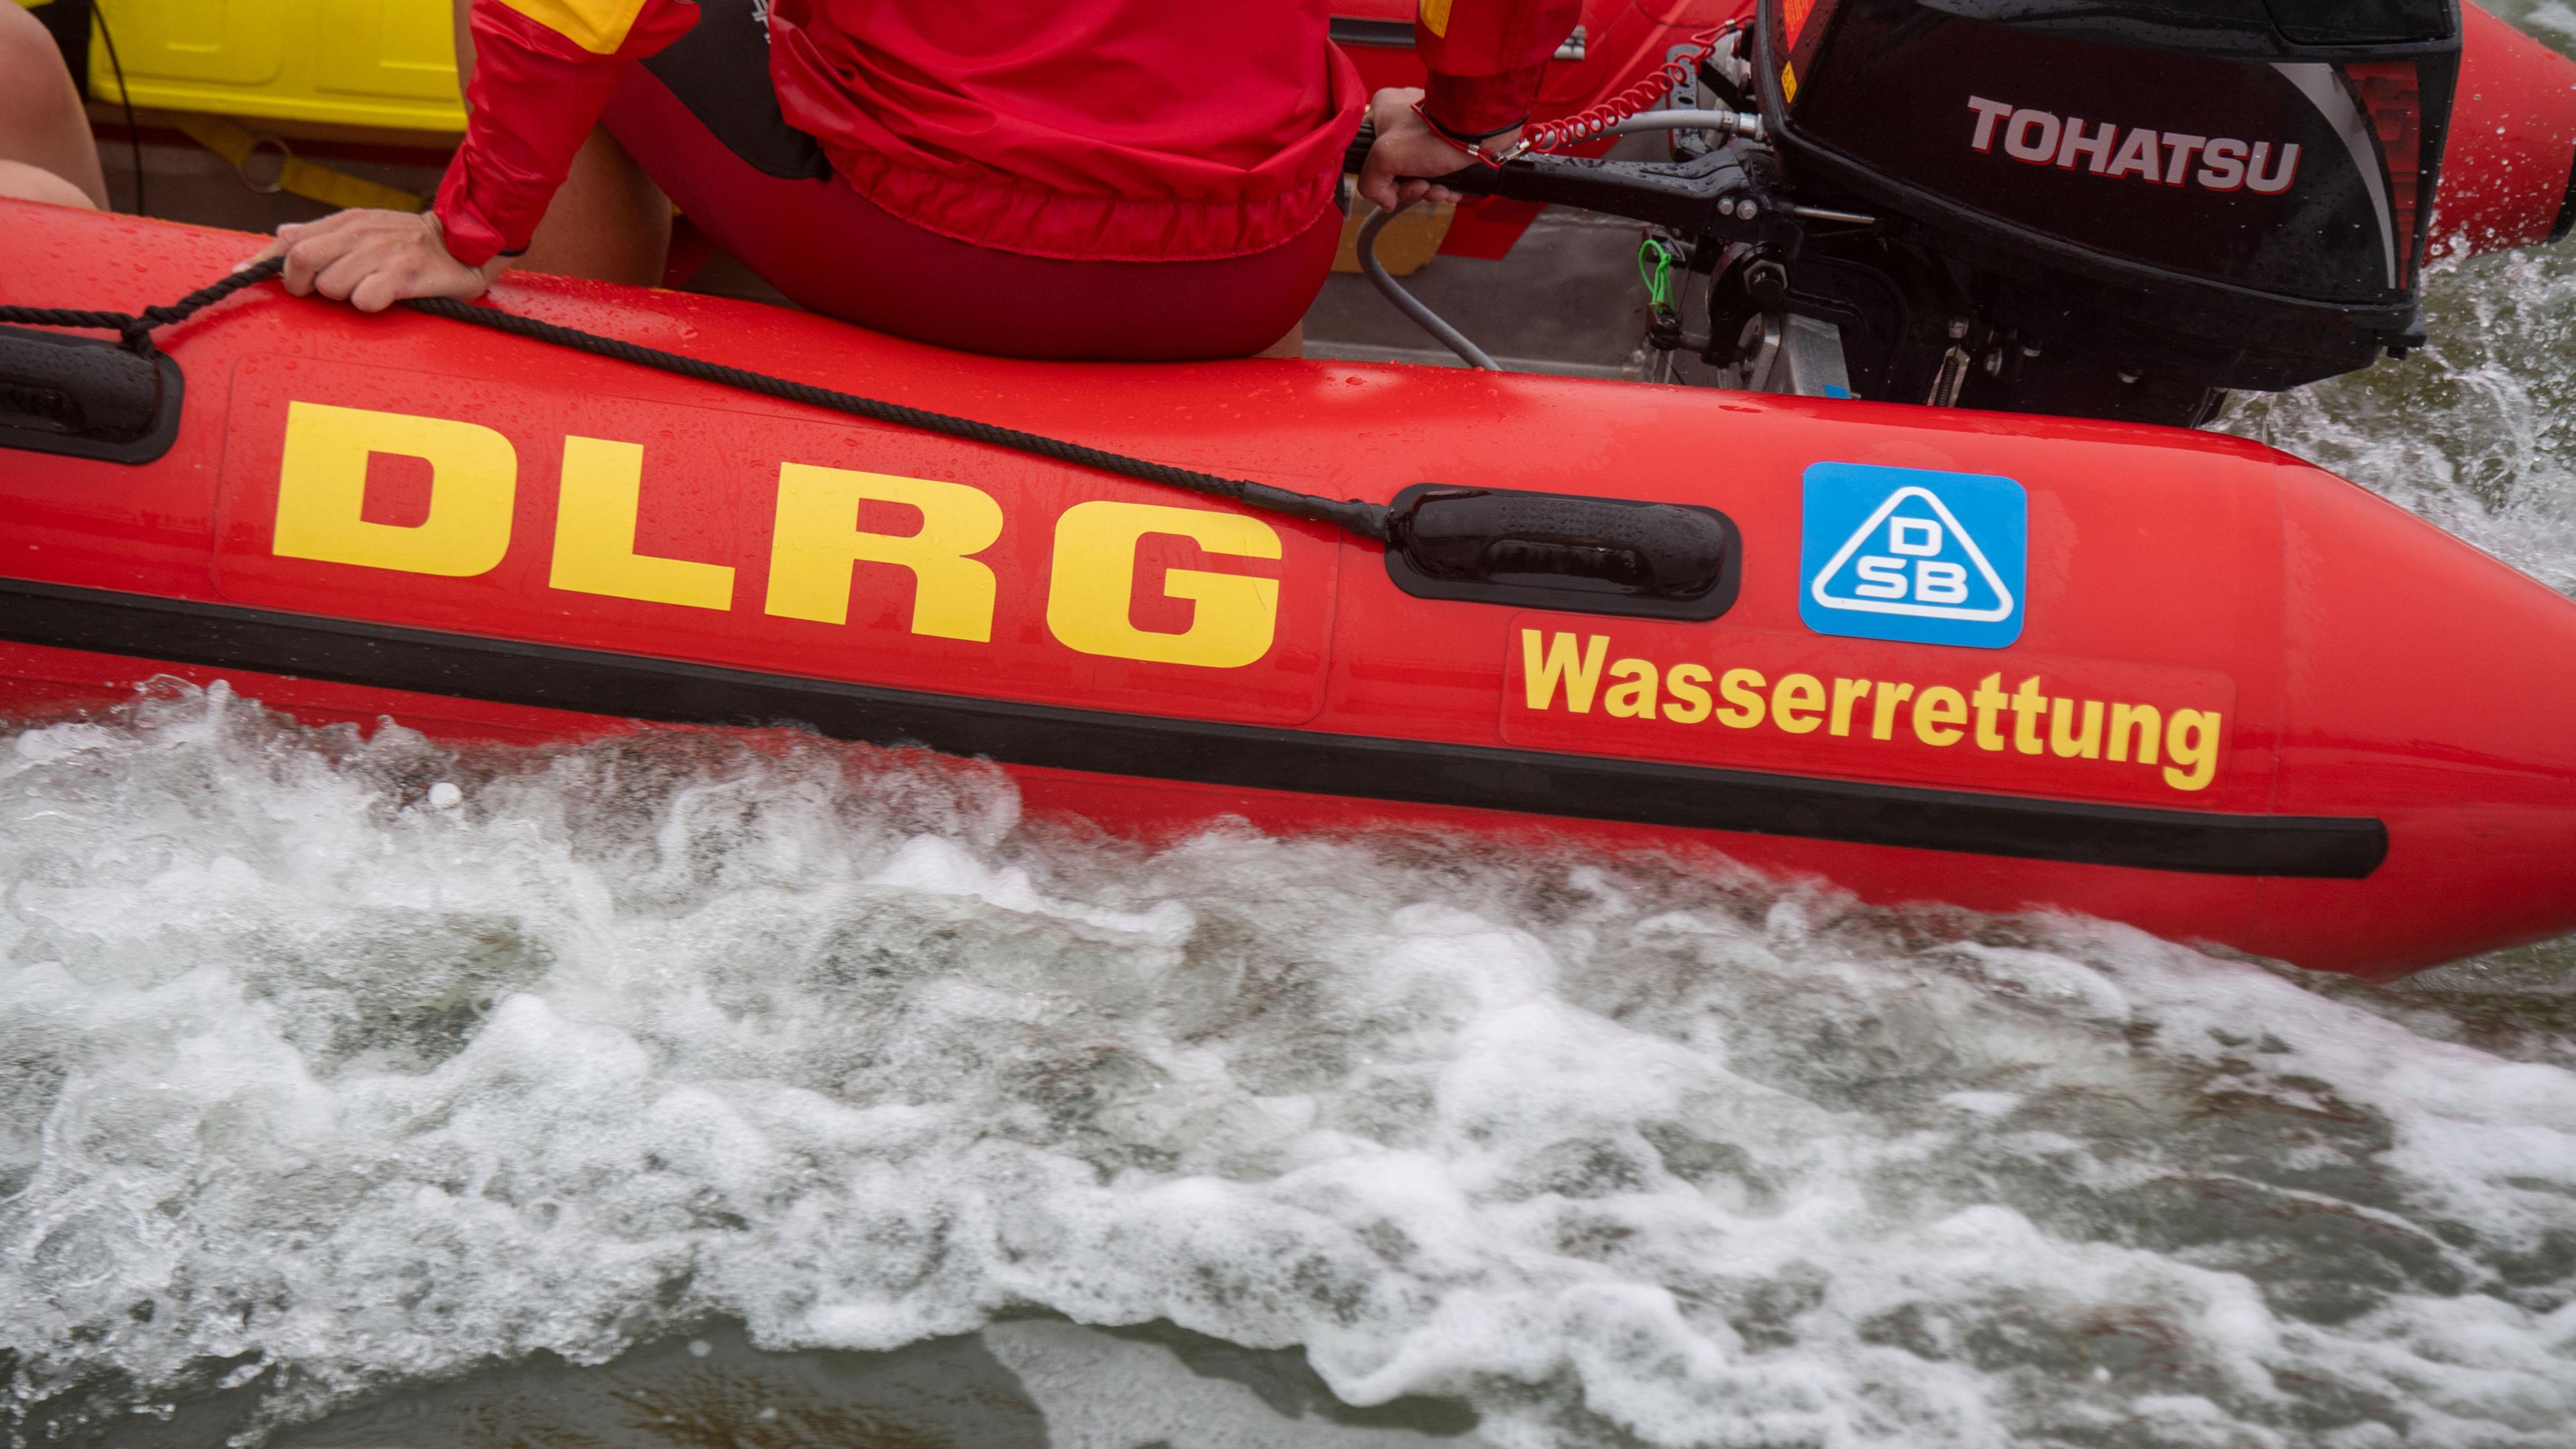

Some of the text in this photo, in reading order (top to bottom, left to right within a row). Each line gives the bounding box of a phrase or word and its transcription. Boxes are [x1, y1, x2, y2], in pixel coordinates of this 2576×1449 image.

[1968, 96, 2300, 194] TOHATSU
[273, 400, 1282, 668] DLRG
[1521, 628, 2222, 792] Wasserrettung
